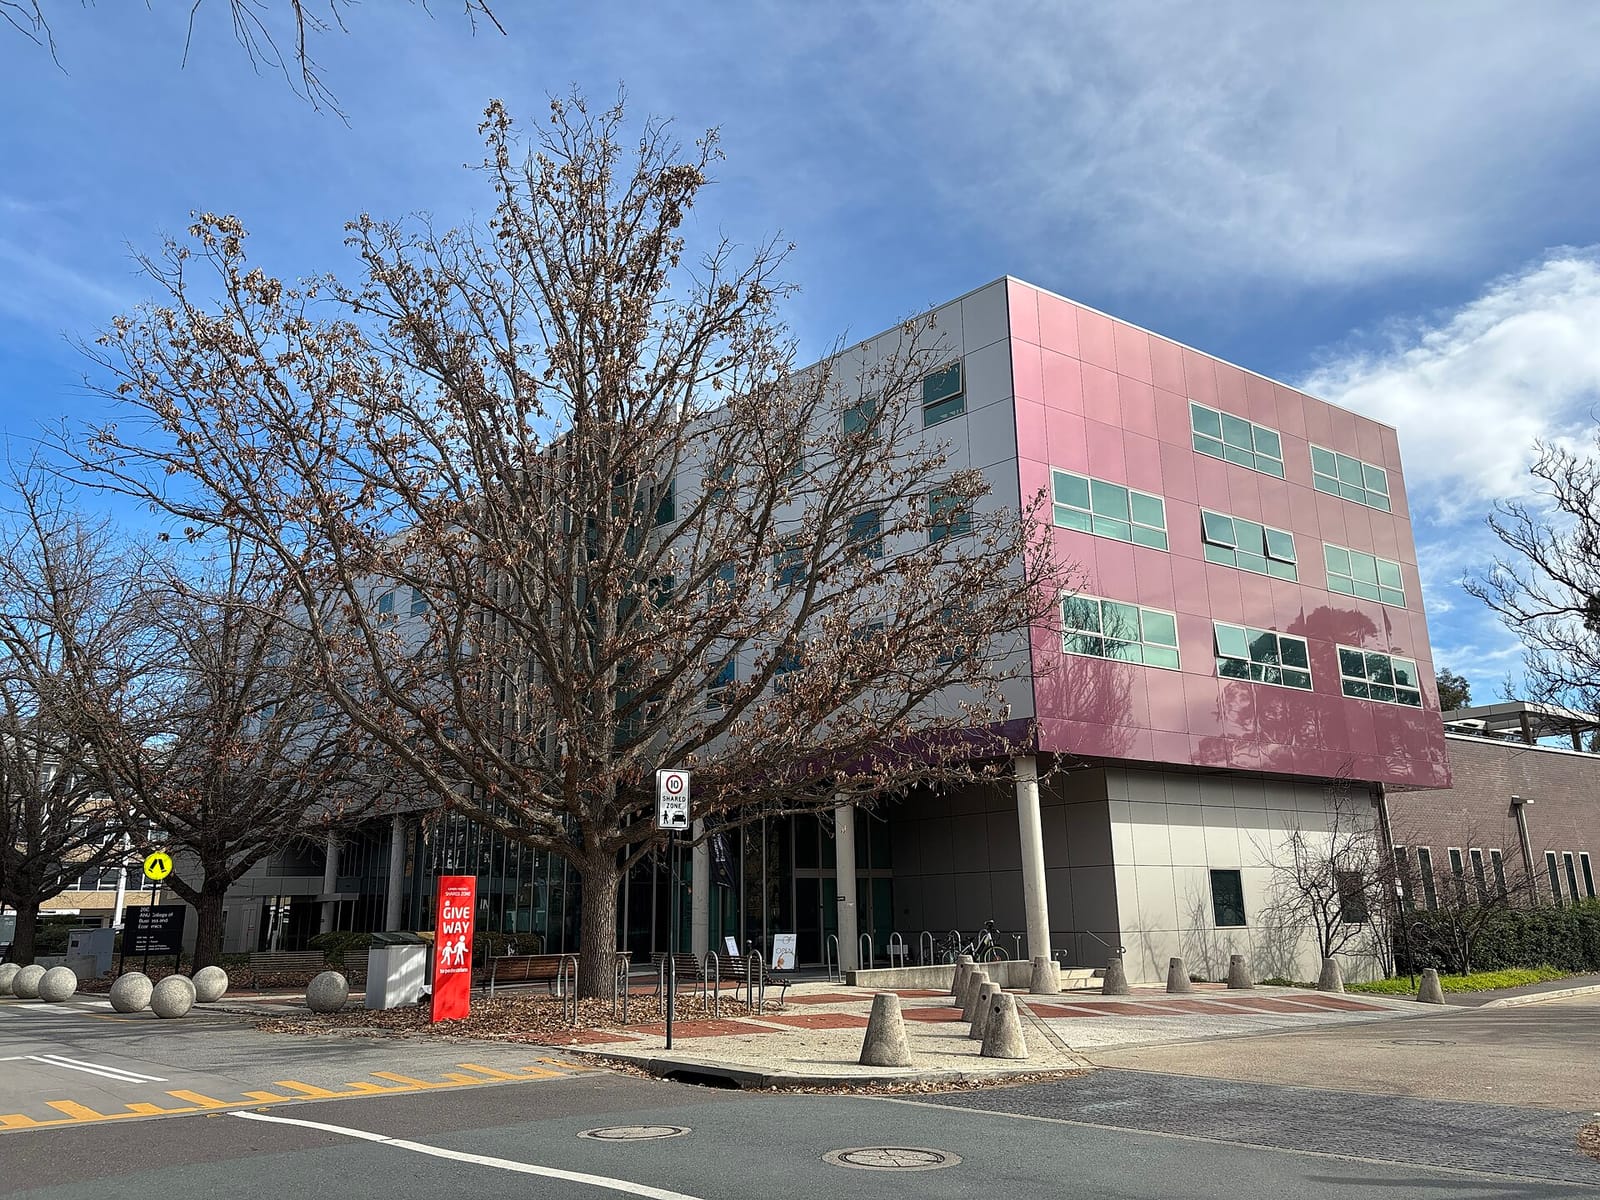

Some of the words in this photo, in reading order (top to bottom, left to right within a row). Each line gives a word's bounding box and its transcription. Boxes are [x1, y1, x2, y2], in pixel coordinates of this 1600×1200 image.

[670, 780, 679, 789] 10
[443, 906, 470, 919] GIVE
[442, 921, 470, 934] WAY
